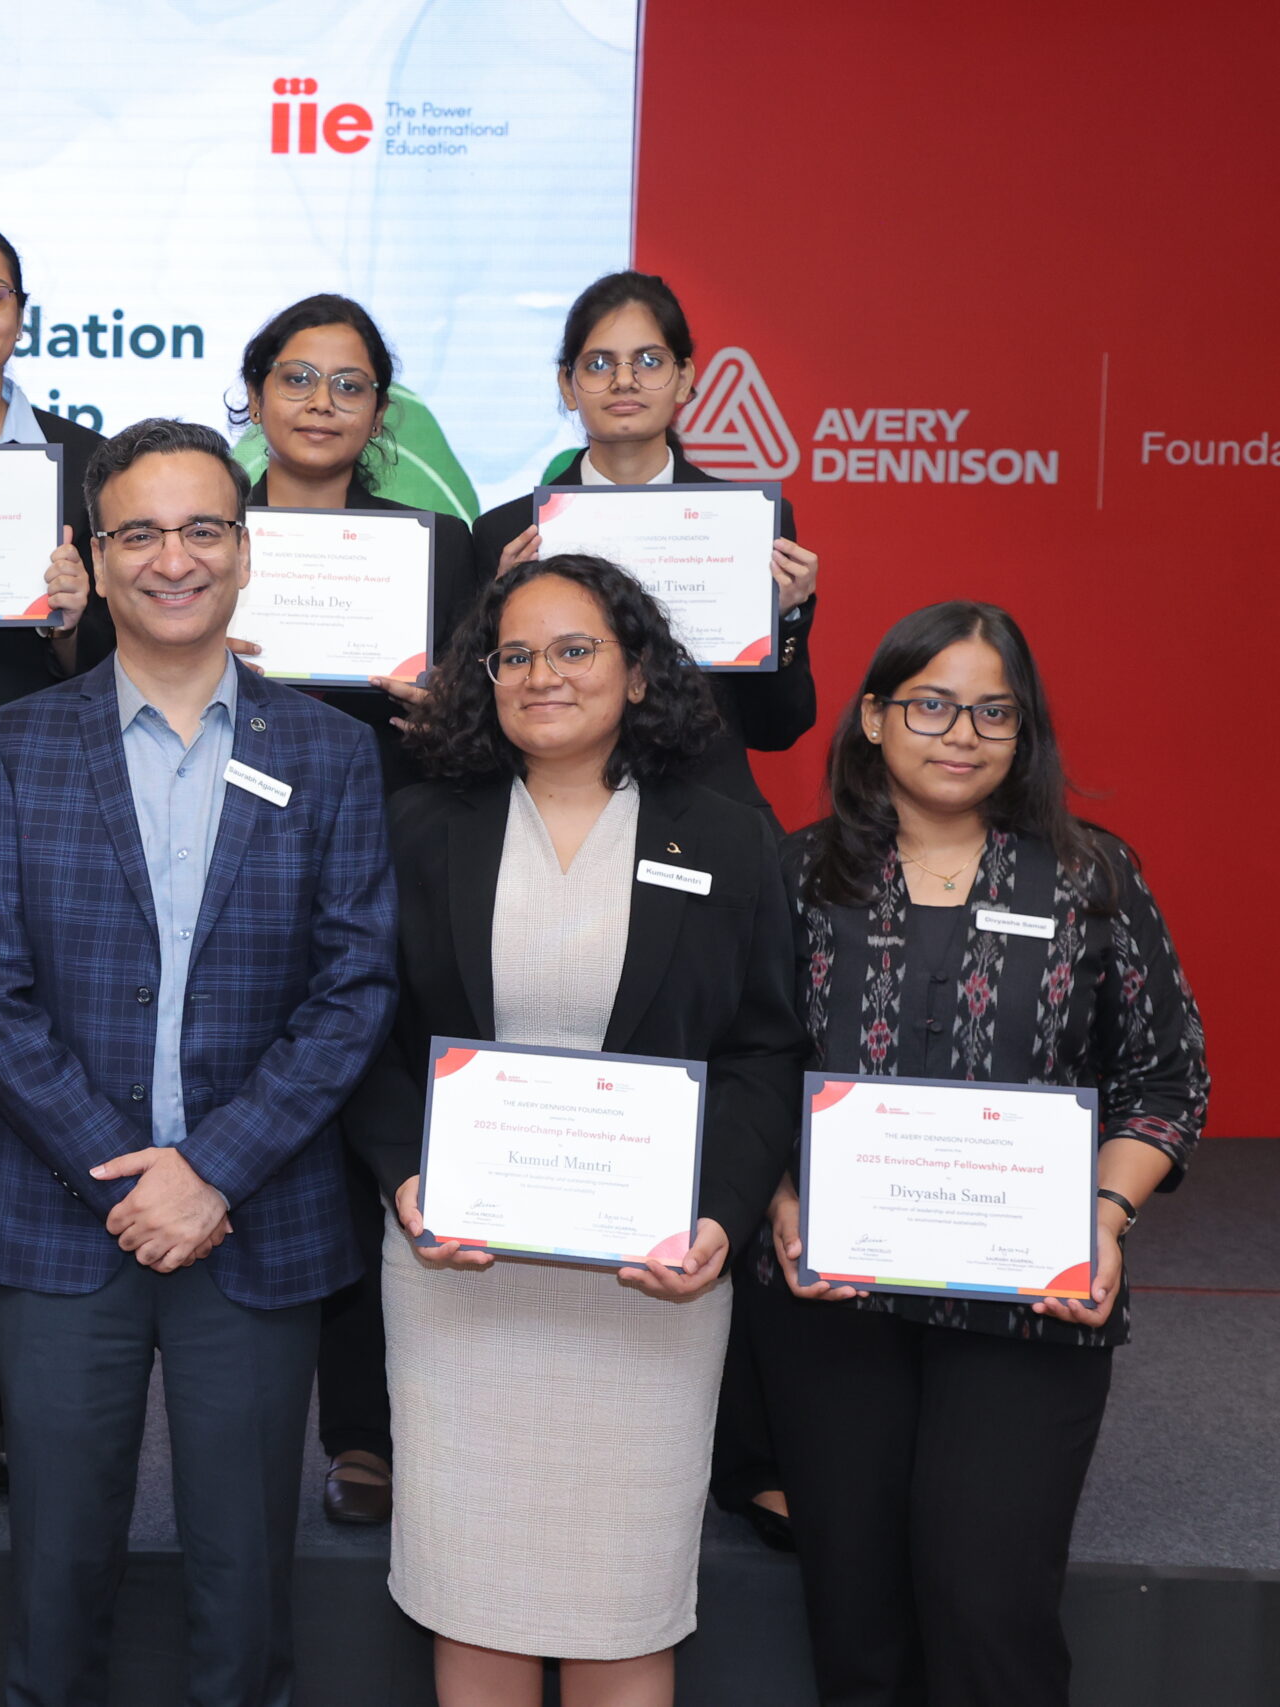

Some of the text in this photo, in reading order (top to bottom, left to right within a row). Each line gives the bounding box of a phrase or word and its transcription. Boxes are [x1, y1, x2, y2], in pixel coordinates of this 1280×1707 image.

[386, 102, 473, 118] The Power
[385, 121, 510, 137] of International
[386, 139, 468, 156] Education
[812, 408, 970, 443] AVERY
[811, 448, 1060, 485] DENNISON
[658, 555, 733, 565] Fellowship Award
[260, 570, 390, 583] EnviroChamp Fellowship Award
[664, 580, 705, 592] Tiwari
[274, 594, 352, 611] Deeksha Dey
[646, 867, 702, 885] Kumud Mantri
[473, 1119, 651, 1144] 2025 EnviroChamp Fellowship Award
[924, 1134, 963, 1143] DENNISON
[964, 1137, 1013, 1146] FOUNDATION
[508, 1151, 612, 1173] Kumud Mantri
[856, 1153, 1043, 1174] 2025 EnviroChamp Fellowship Award
[890, 1184, 1006, 1205] Divyasha Samal
